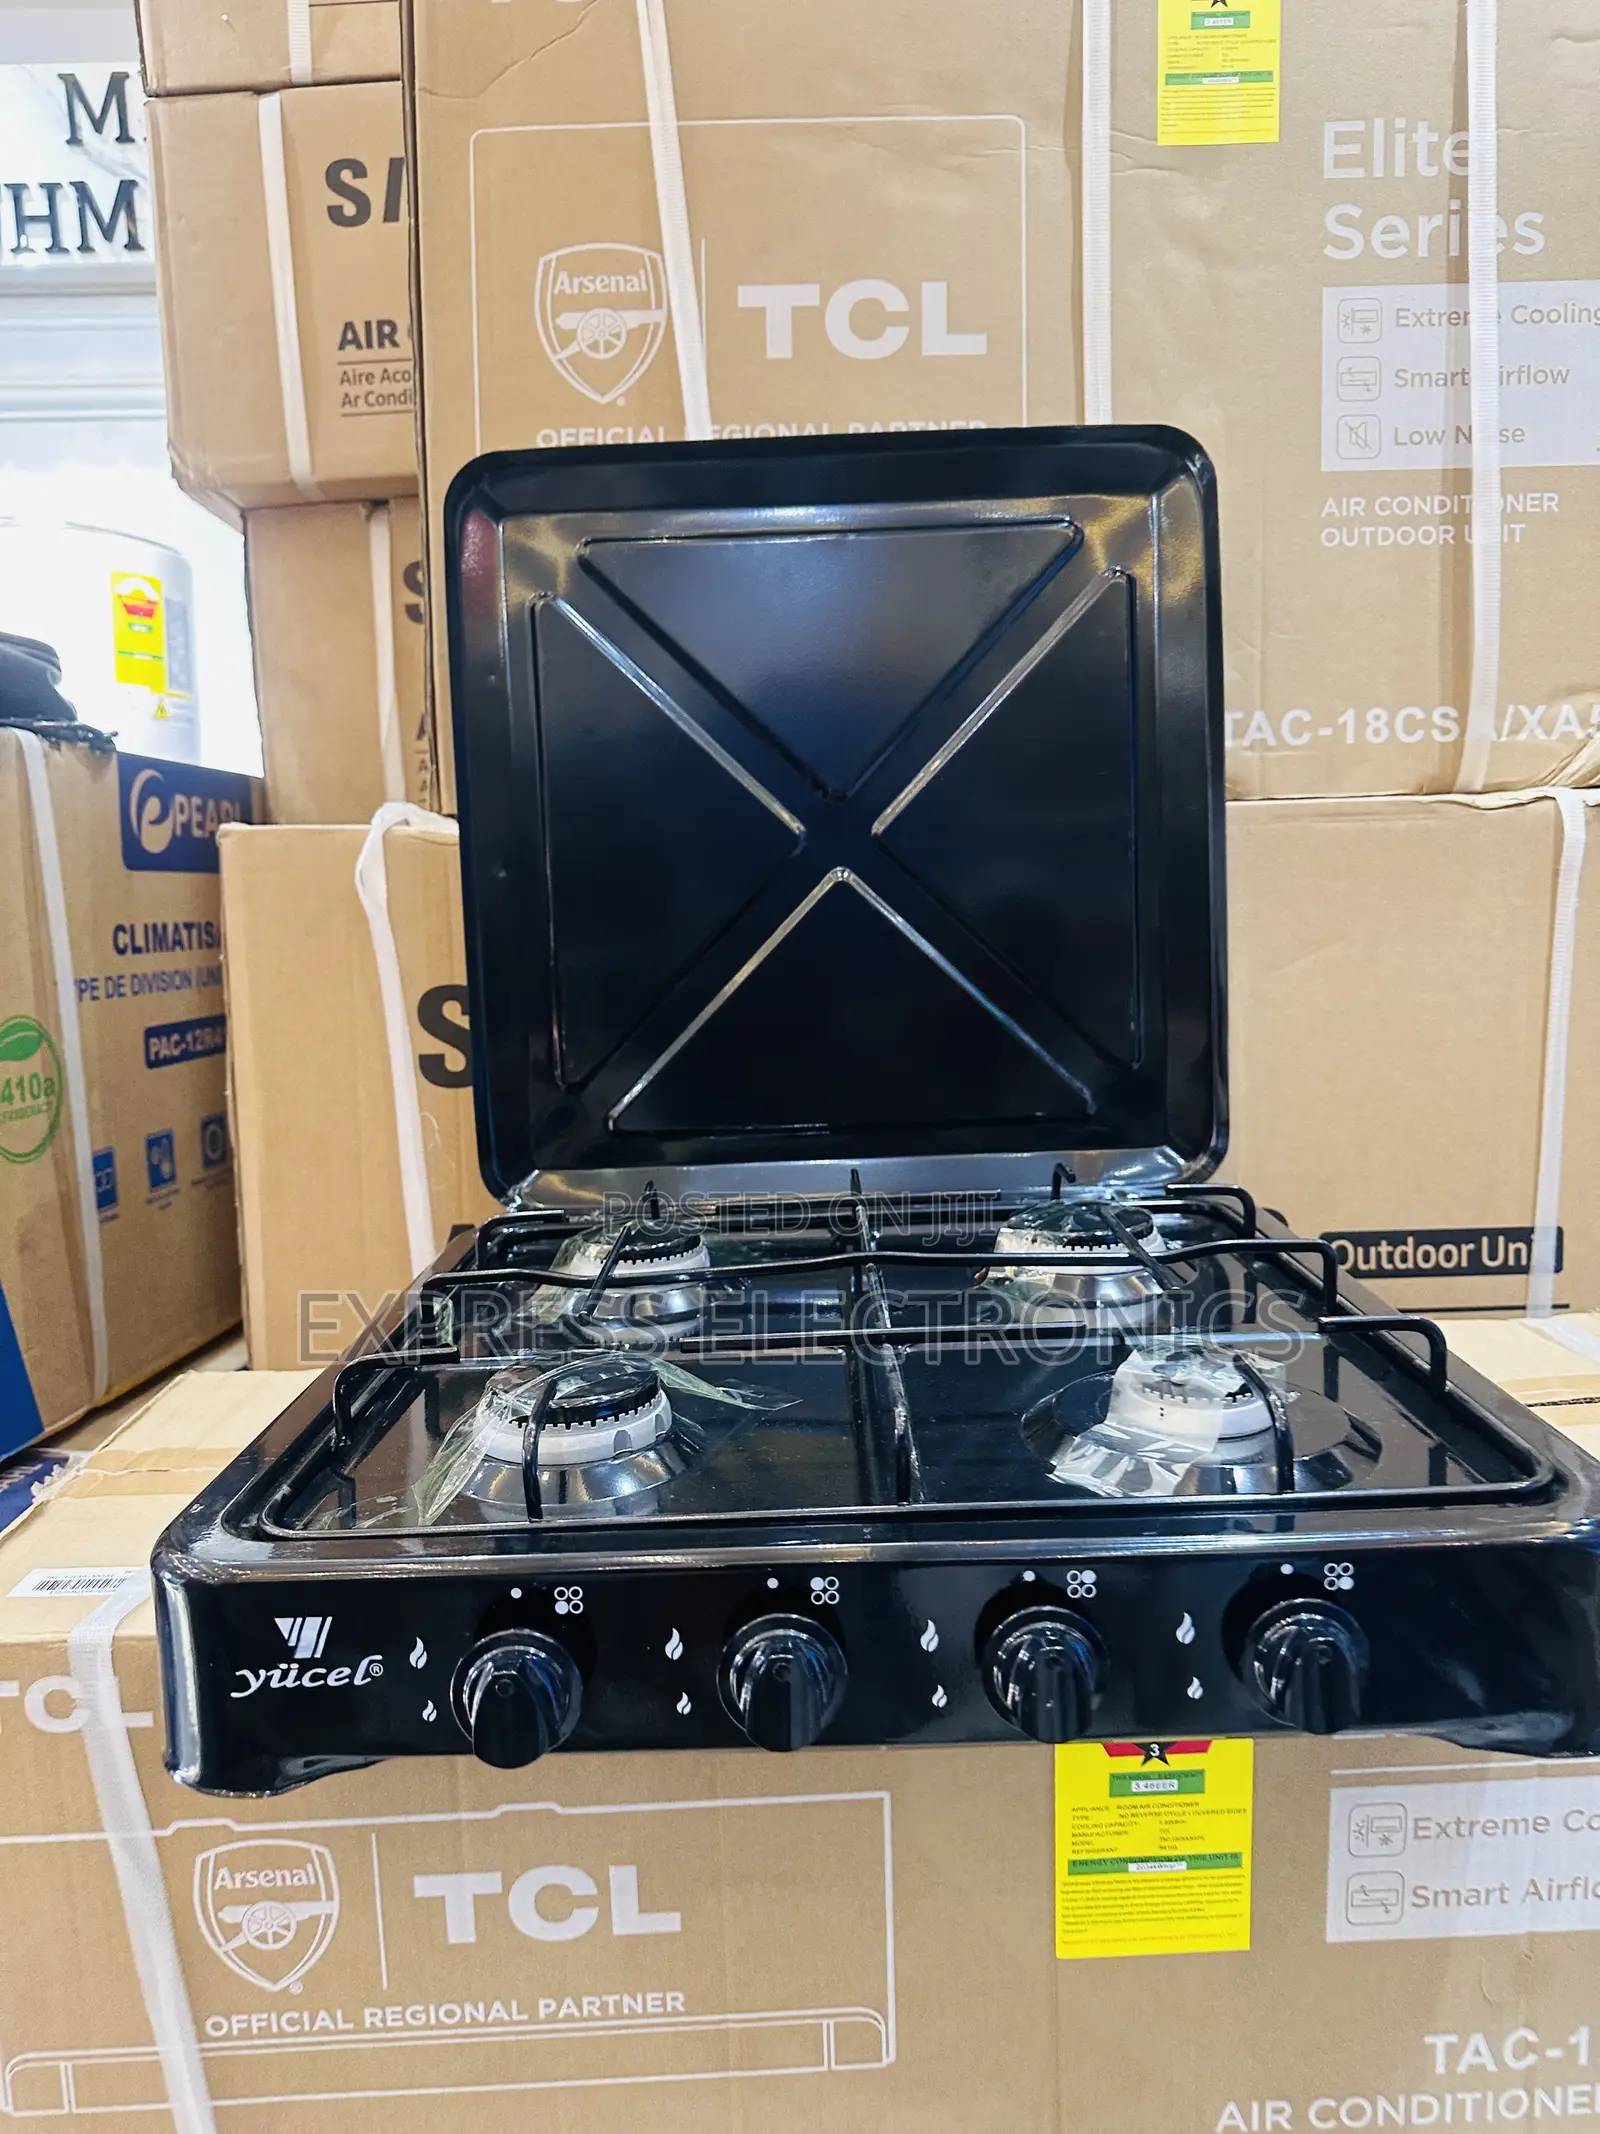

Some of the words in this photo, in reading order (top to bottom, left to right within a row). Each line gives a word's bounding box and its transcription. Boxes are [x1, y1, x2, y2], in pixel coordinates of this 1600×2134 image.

[56, 71, 146, 146] M
[1323, 118, 1469, 179] Elite
[1323, 199, 1545, 260] Seris
[553, 268, 648, 294] Arsenal
[737, 279, 988, 360] TCL
[1395, 307, 1502, 328] Extre
[337, 319, 400, 351] AIR
[340, 368, 375, 386] Aire
[1499, 364, 1571, 387] irflow
[341, 392, 361, 408] Ar
[1394, 426, 1446, 446] Low
[1455, 424, 1526, 445] Nse
[1320, 497, 1366, 518] AIR
[1374, 492, 1560, 516] CONDITNER
[1320, 525, 1456, 547] OUTDOOR
[1464, 523, 1526, 544] UIT
[75, 977, 100, 1002] PE
[104, 975, 127, 999] DE
[1330, 1236, 1475, 1271] Outdoor
[1481, 1233, 1534, 1267] Un
[1149, 1743, 1160, 1757] 3
[1412, 1813, 1551, 1841] Extreme
[214, 1862, 318, 1891] Arsenal
[413, 1864, 682, 1944] TCL
[1411, 1883, 1510, 1909] Smart
[204, 2008, 354, 2037] OFFICIAL
[363, 2000, 529, 2030] REGIONAL
[538, 1991, 687, 2019] PARTNER
[1214, 2099, 1294, 2133] AIR
[1307, 2084, 1600, 2130] CONDITIONE
